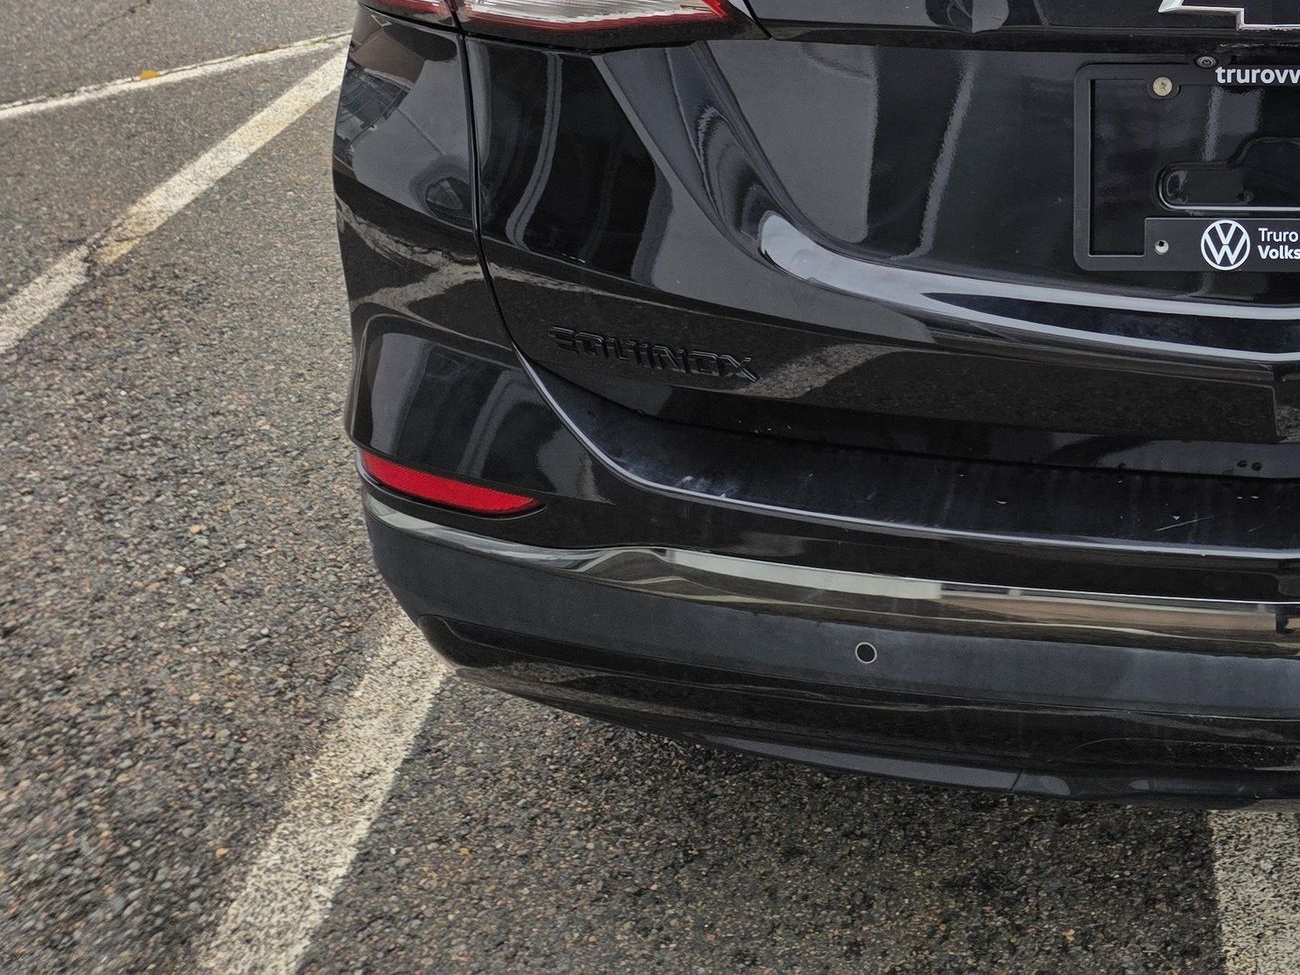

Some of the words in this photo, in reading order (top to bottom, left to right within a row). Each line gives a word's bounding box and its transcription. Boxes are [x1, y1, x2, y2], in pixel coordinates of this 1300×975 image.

[1200, 219, 1251, 271] VW
[1258, 227, 1299, 243] Truro
[549, 326, 760, 383] EQUINOX
